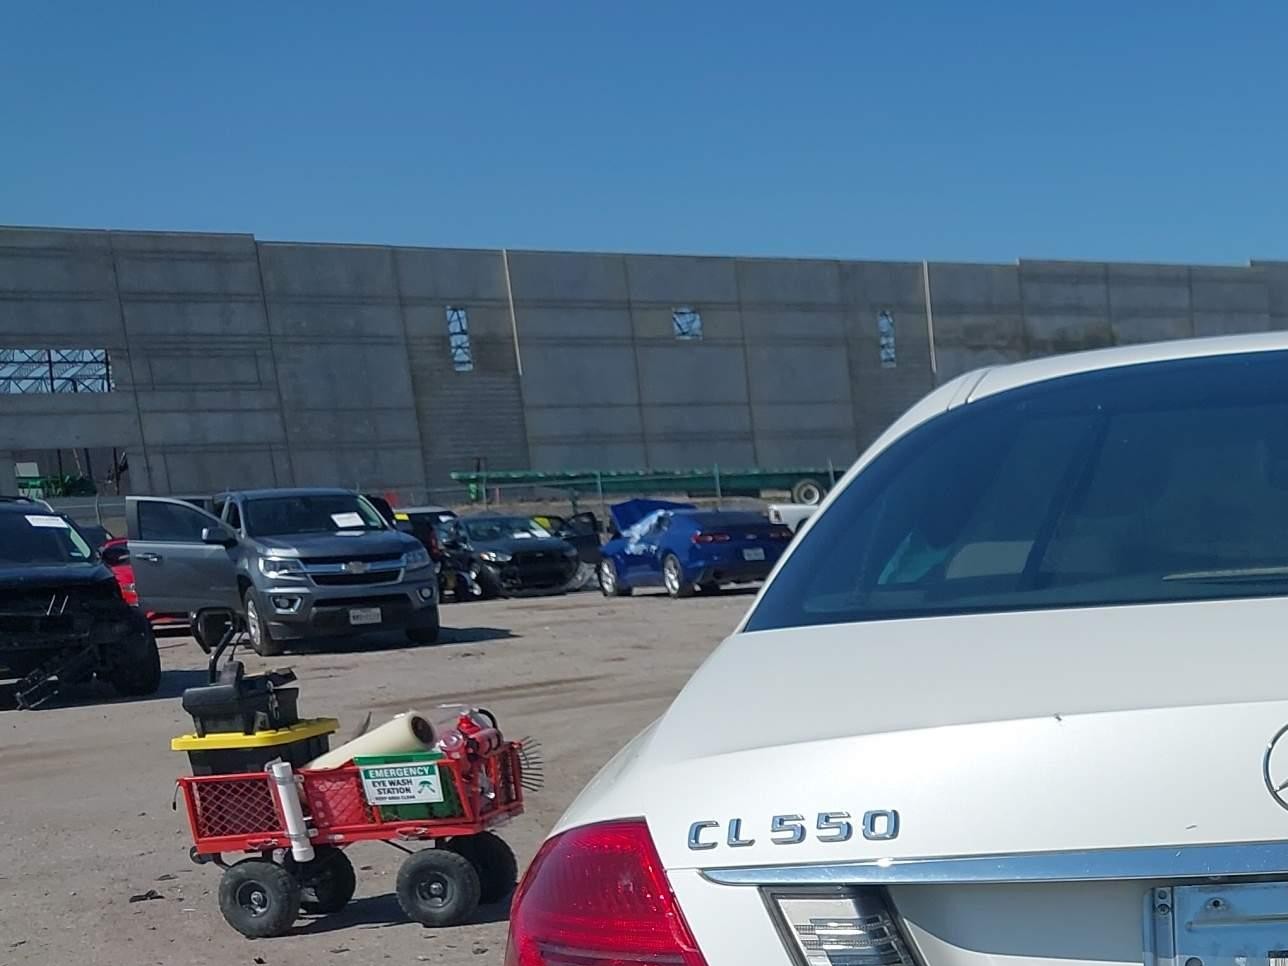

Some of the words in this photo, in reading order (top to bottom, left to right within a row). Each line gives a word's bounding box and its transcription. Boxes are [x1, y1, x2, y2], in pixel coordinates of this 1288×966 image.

[368, 766, 430, 778] EMERGENCY
[372, 780, 387, 788] EYE
[376, 787, 411, 795] STATION
